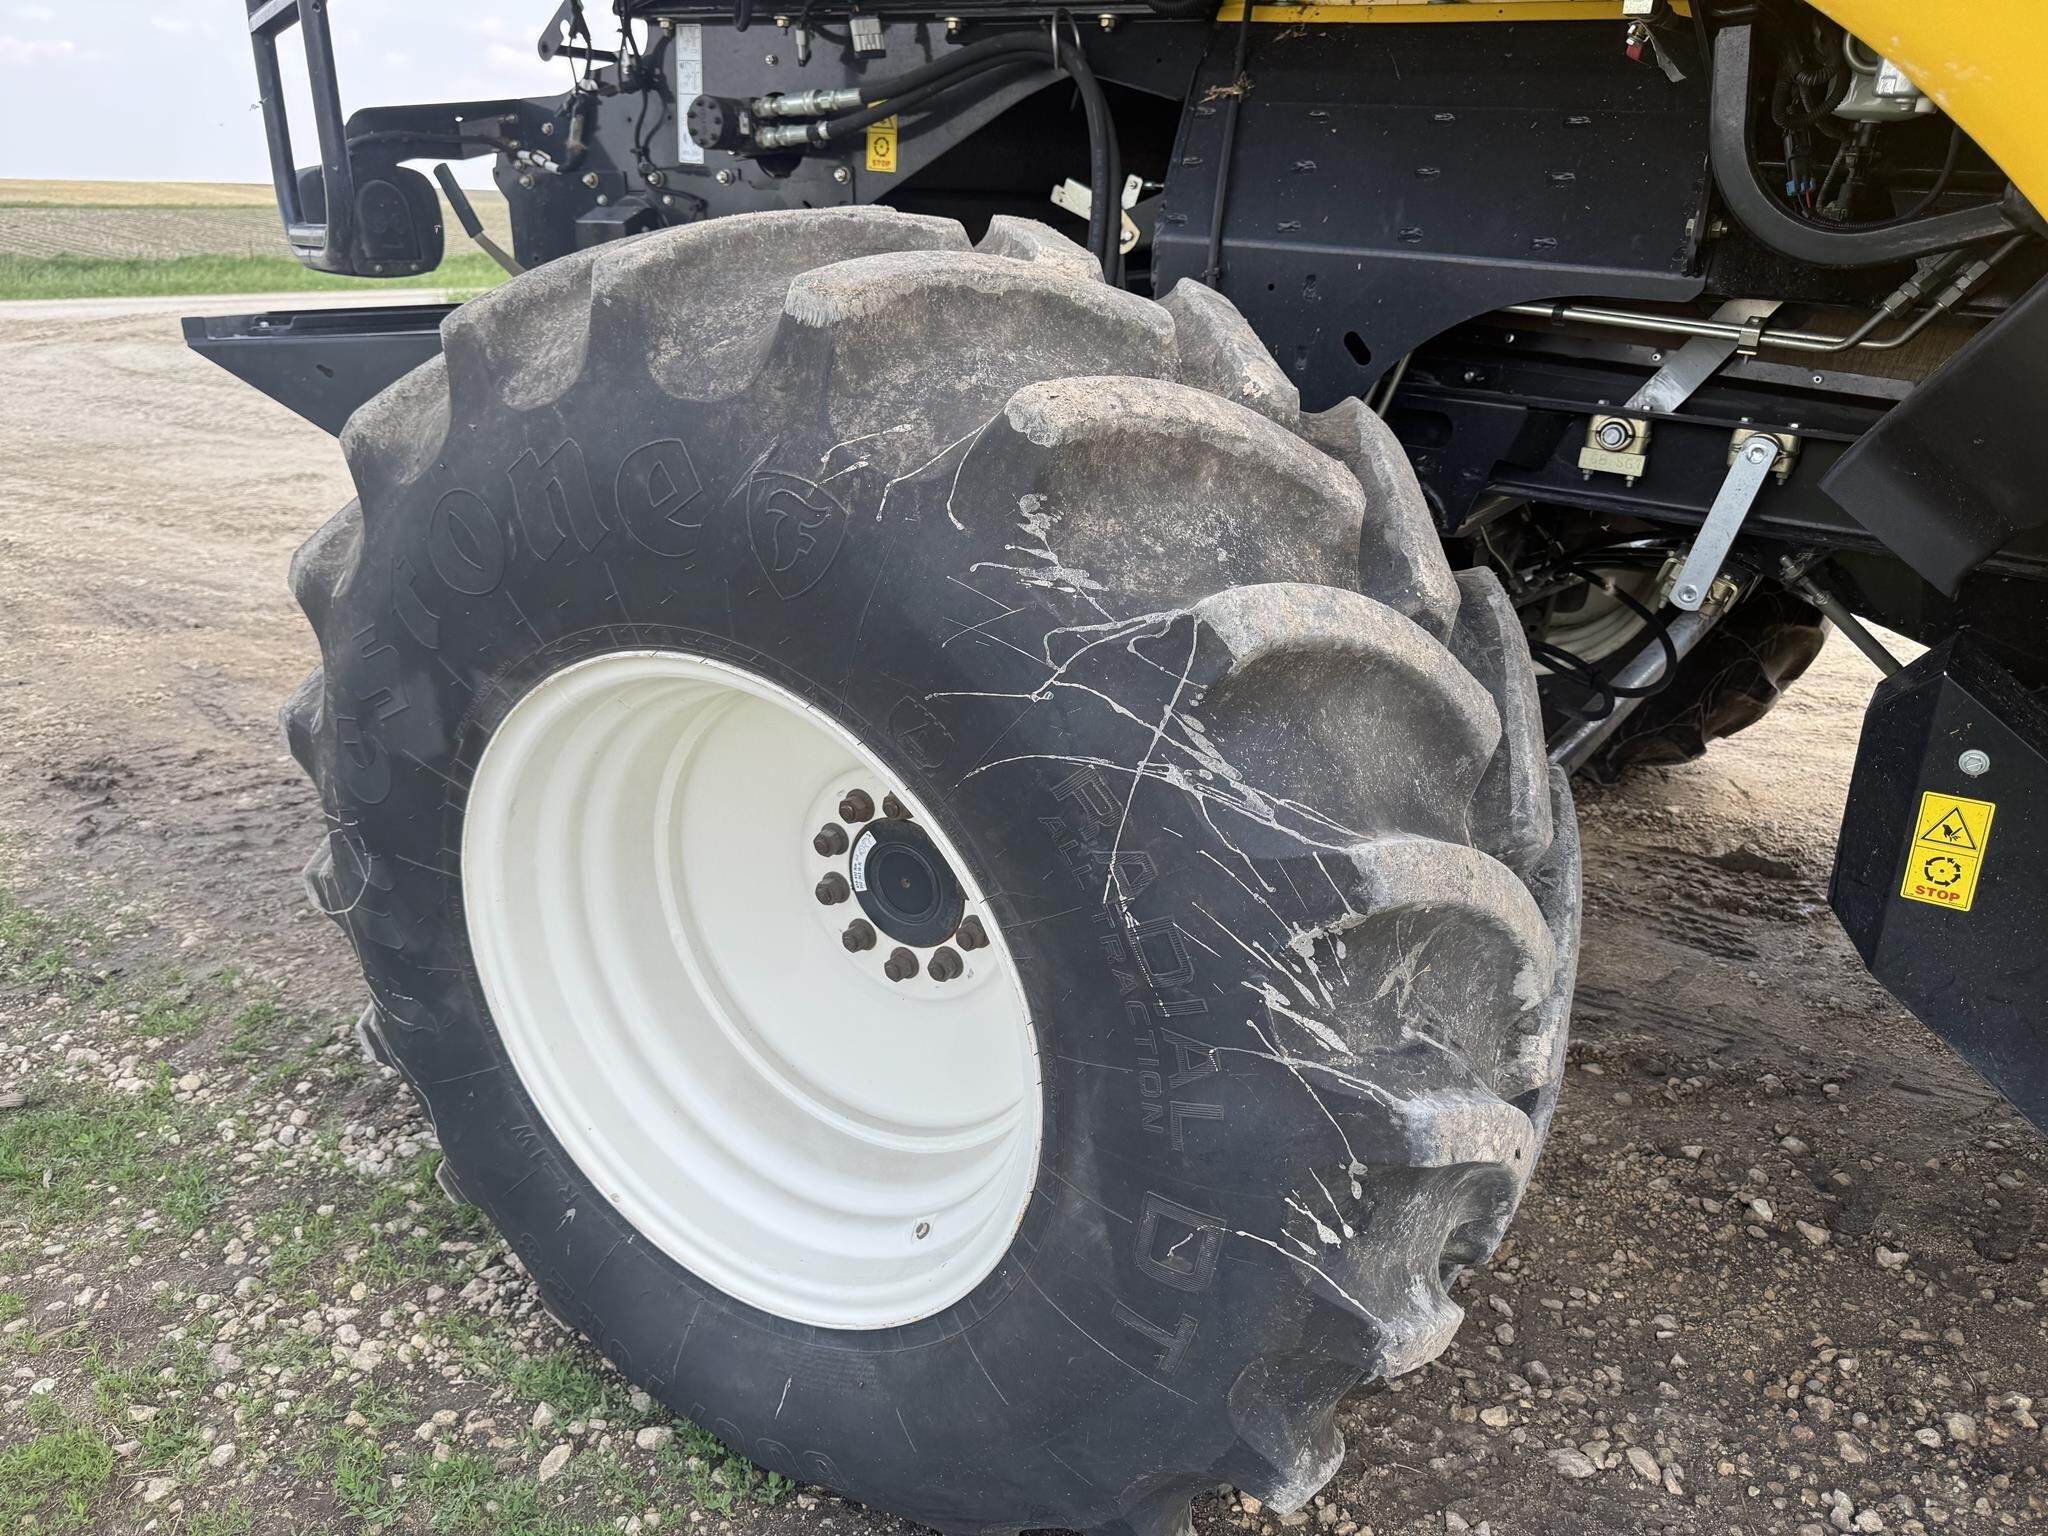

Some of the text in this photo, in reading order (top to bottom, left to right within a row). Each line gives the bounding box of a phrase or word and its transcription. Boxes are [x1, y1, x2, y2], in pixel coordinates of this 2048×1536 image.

[1914, 884, 1961, 901] STOP
[1051, 764, 1228, 1375] RADIAL DT
